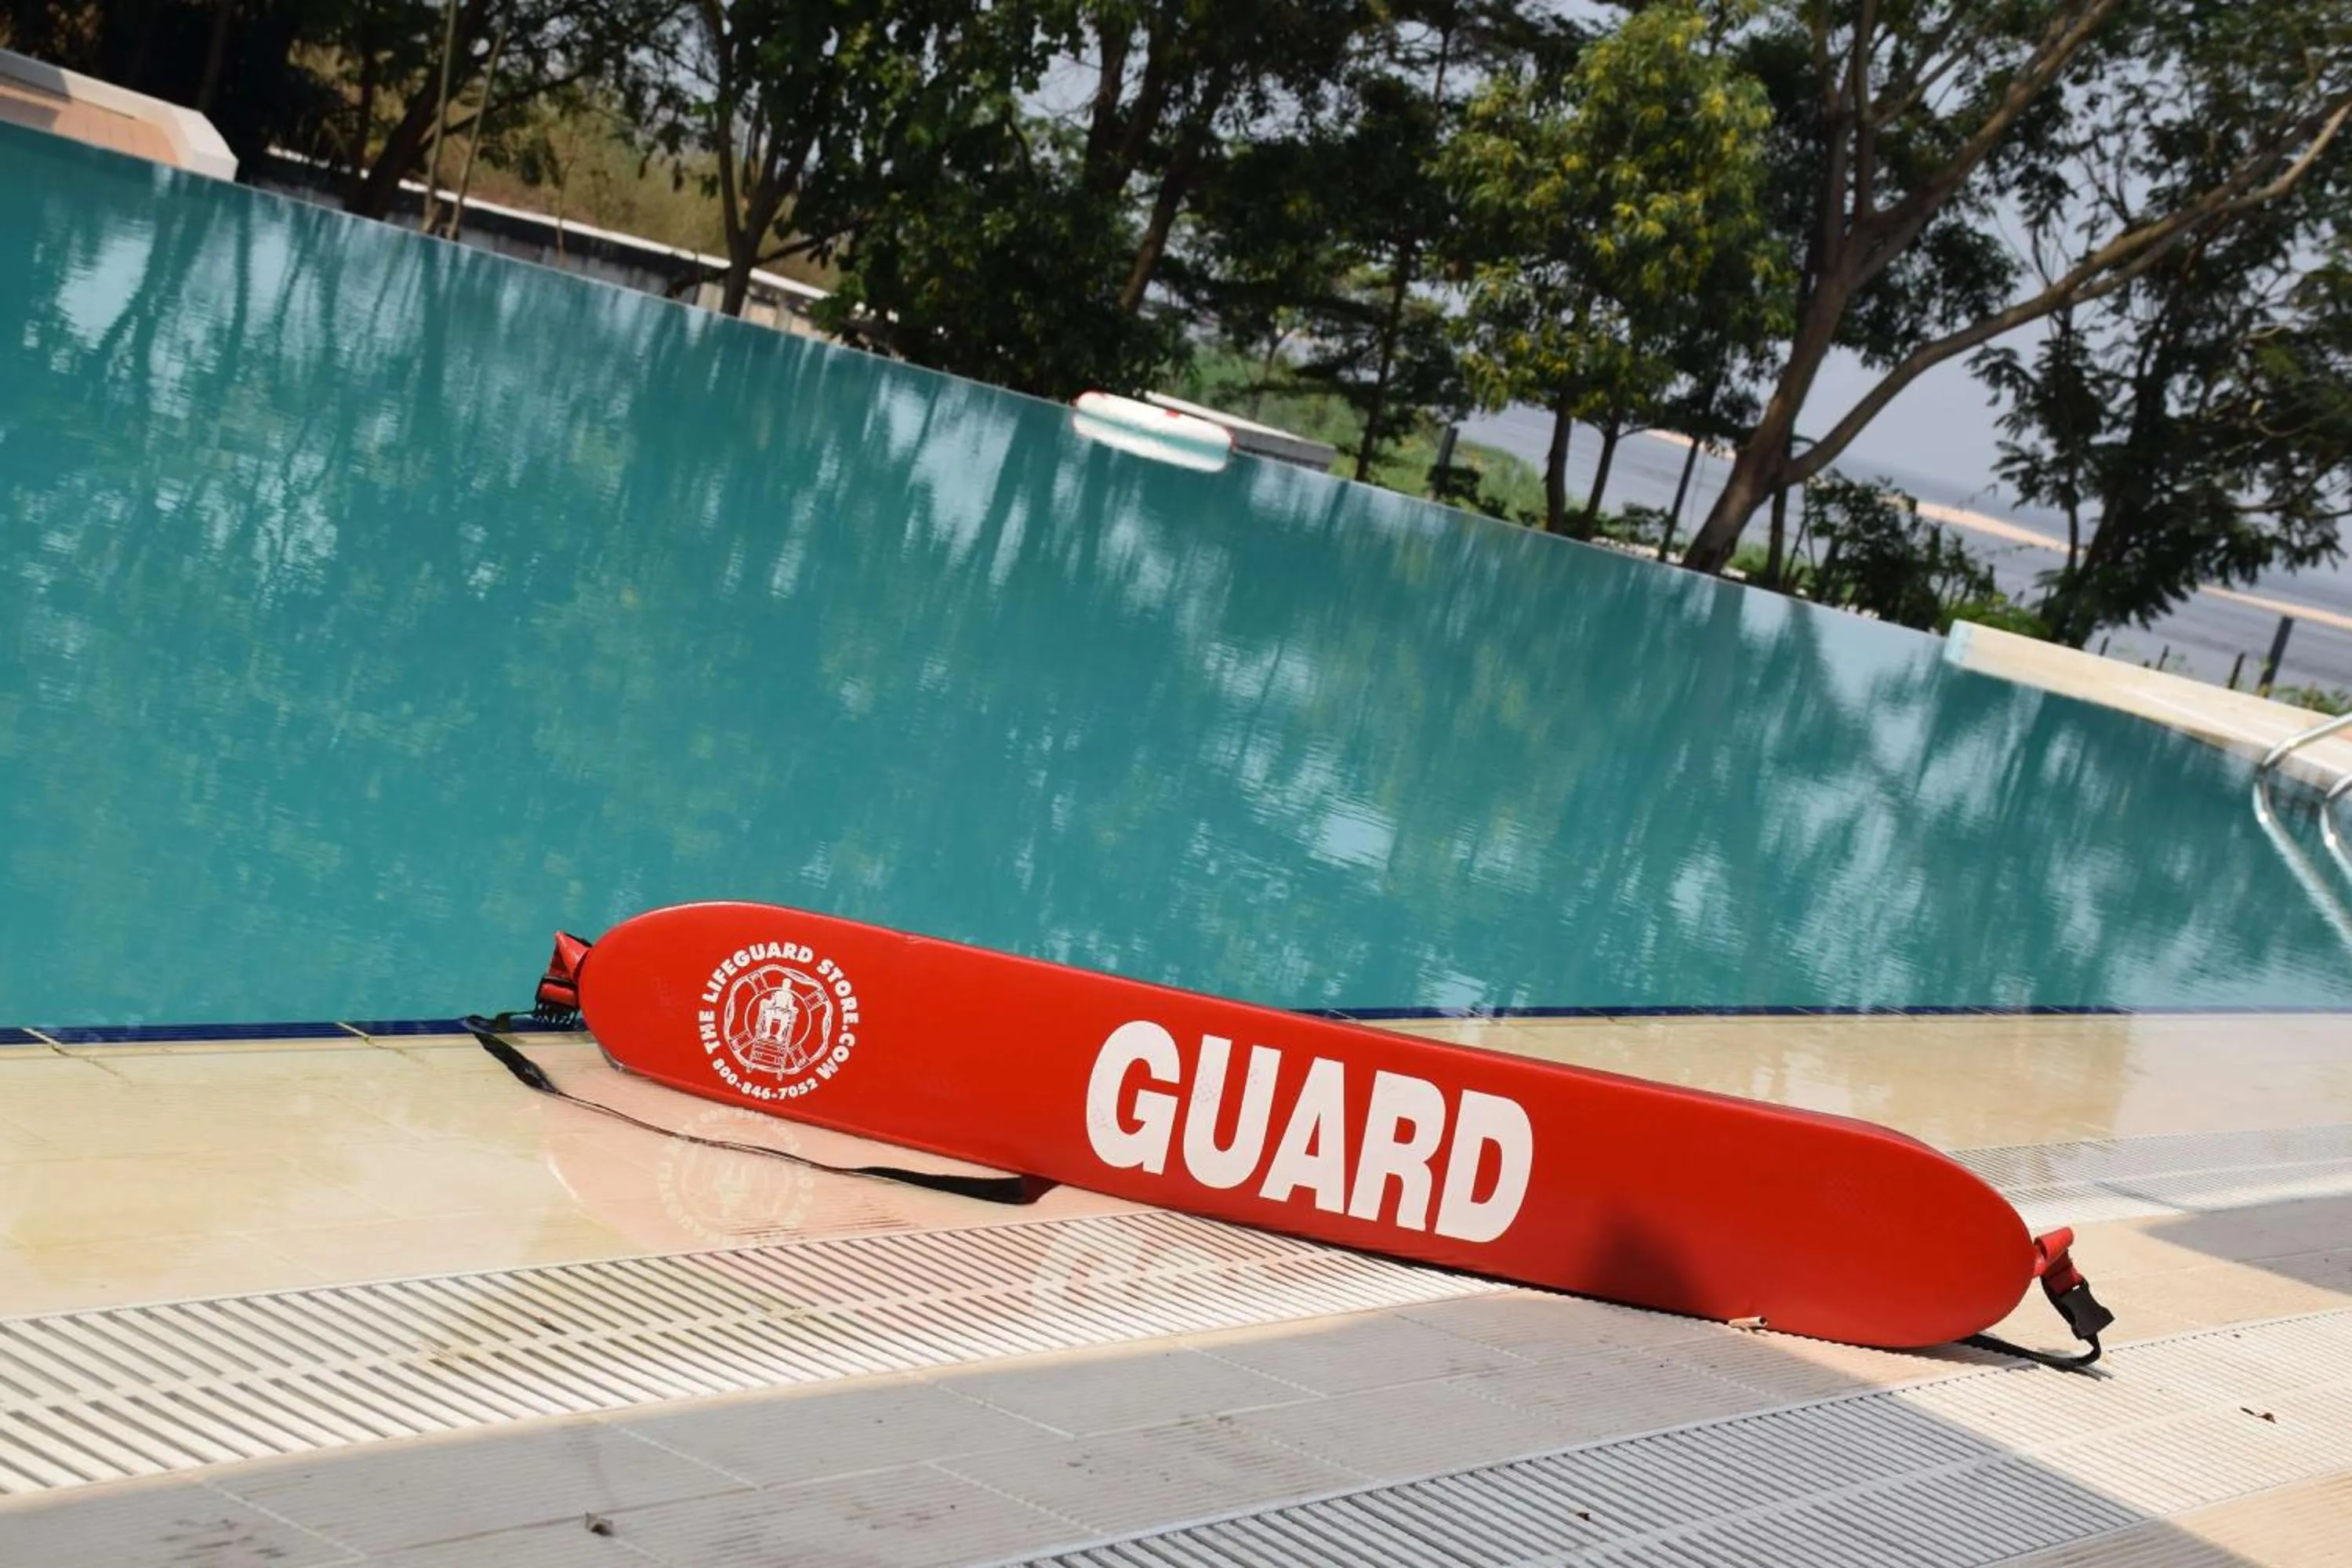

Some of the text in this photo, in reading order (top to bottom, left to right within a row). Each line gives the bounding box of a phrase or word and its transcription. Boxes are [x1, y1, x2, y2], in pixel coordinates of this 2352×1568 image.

[699, 942, 859, 1080] THE LIFEGUARD STORE.COM
[712, 1058, 818, 1100] 800-846-7052
[1085, 1019, 1534, 1244] GUARD
